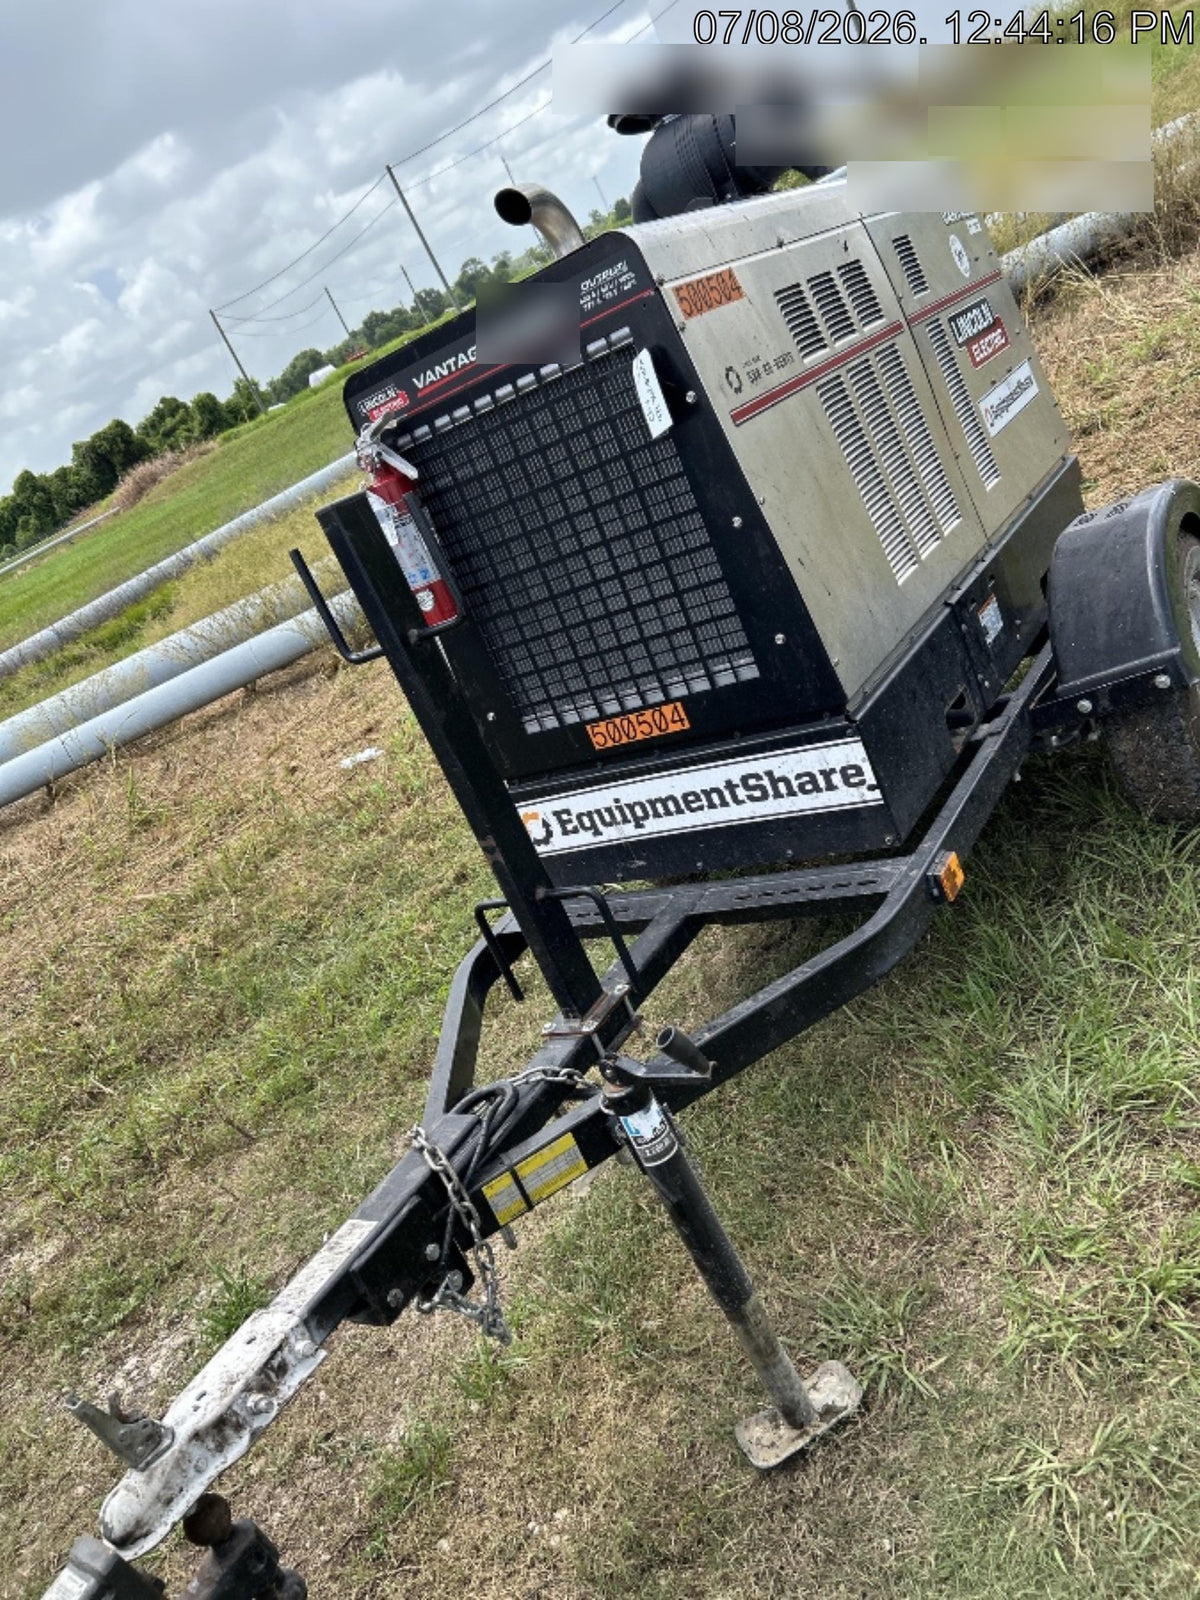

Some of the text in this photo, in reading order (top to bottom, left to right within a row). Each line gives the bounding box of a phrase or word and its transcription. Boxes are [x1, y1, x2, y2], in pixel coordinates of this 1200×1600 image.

[673, 268, 742, 317] 500504
[412, 345, 477, 390] VANTAG
[589, 704, 687, 748] 500504
